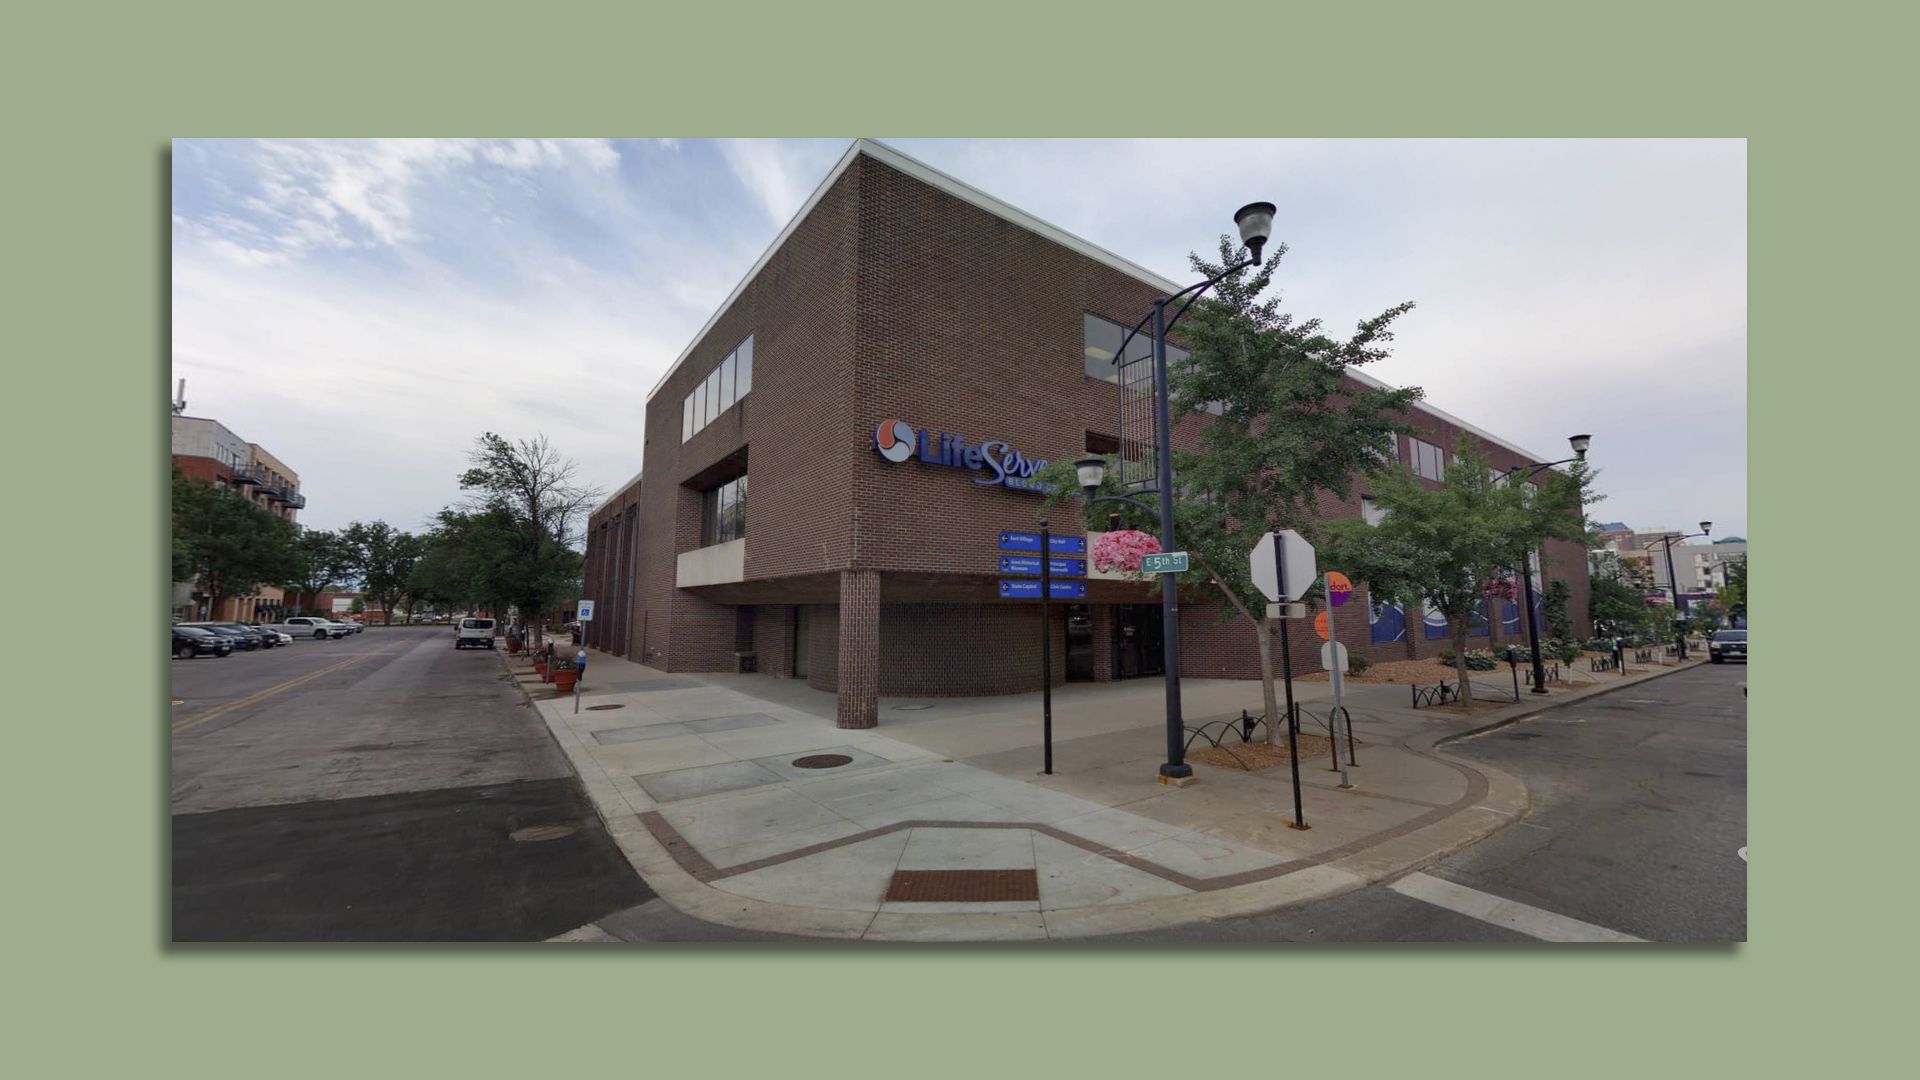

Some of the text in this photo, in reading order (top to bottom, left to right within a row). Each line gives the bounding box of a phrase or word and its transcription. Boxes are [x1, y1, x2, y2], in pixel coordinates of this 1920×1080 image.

[1146, 556, 1182, 570] E 5th St
